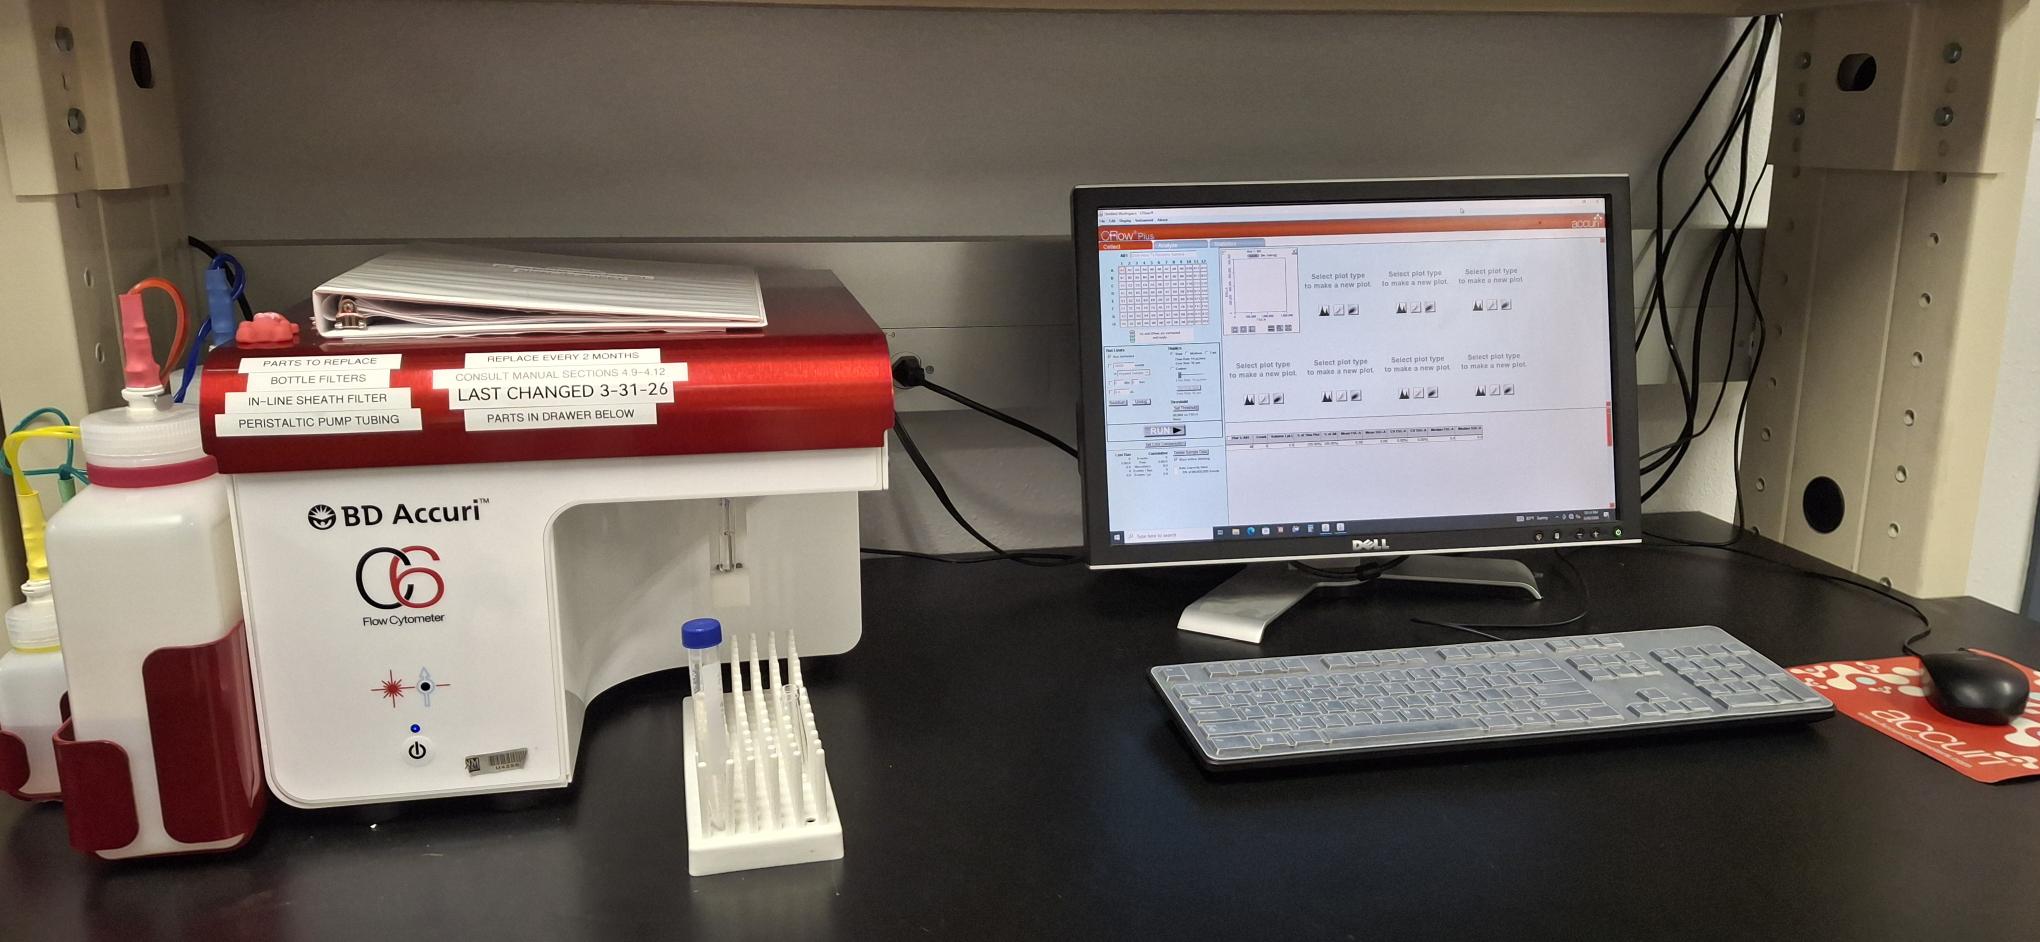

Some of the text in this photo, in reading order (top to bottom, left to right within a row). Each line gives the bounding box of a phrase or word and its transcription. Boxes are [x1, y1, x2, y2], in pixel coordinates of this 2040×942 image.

[323, 357, 378, 366] REPLACE
[488, 354, 540, 363] REPLACE
[543, 353, 579, 362] EVERY
[592, 352, 640, 360] MONTHS
[270, 374, 367, 385] BOTTLE FILTERS
[455, 371, 509, 382] CONSULT
[512, 370, 559, 380] MANUAL
[562, 368, 618, 379] SECTIONS
[458, 382, 668, 402] LAST CHANGED 3-31-26
[248, 393, 387, 407] IN-LINE SHEATH FILTER
[238, 414, 400, 429] PERISTALTIC PUMP TUBING
[487, 408, 635, 424] PARTS IN DRAWER BELOW
[1150, 427, 1170, 435] RUN
[340, 504, 383, 527] BD
[1352, 538, 1390, 551] DELL
[356, 546, 444, 610] C6
[362, 614, 445, 626] Flow Cytometer
